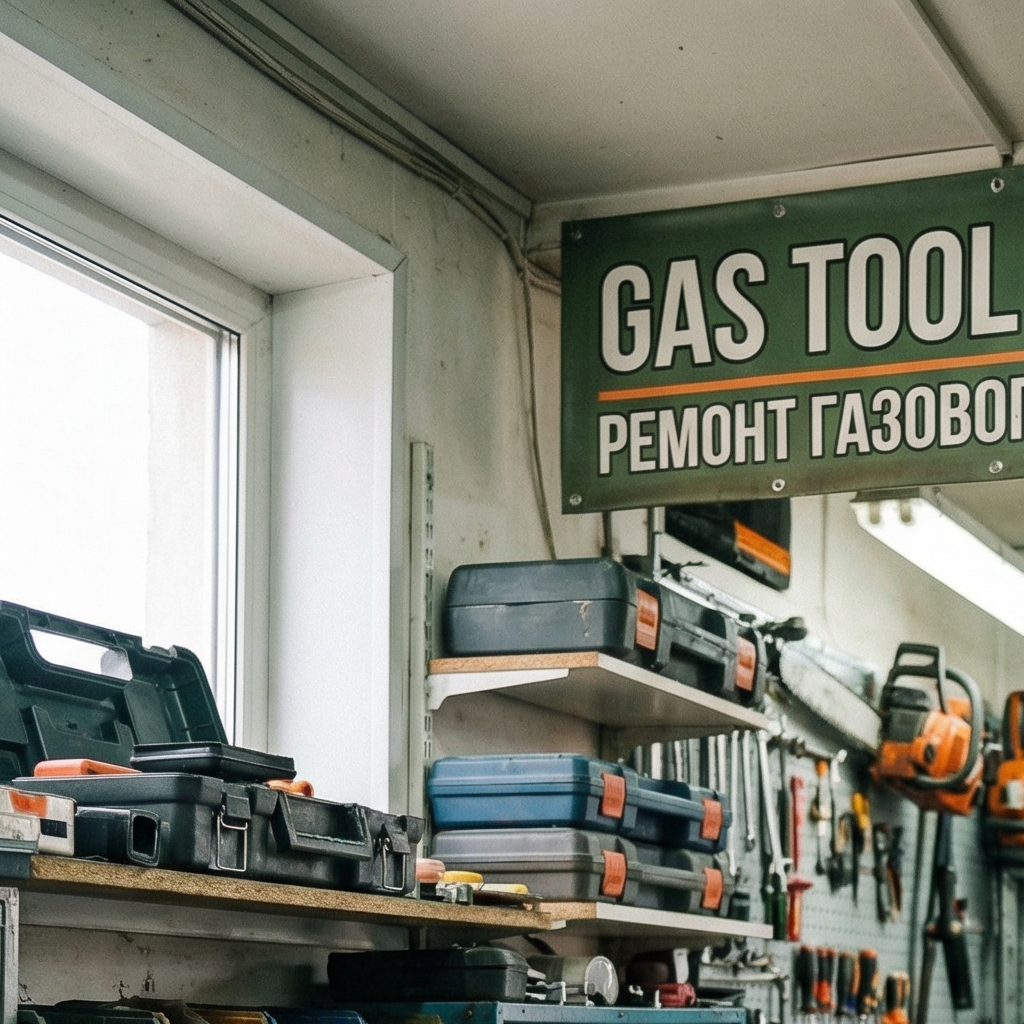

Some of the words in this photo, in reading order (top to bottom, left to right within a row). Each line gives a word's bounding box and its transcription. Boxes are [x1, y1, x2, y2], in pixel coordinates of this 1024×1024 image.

[601, 252, 768, 372] GAS
[792, 226, 1018, 353] TOOL
[599, 399, 796, 474] РЕМОНТ
